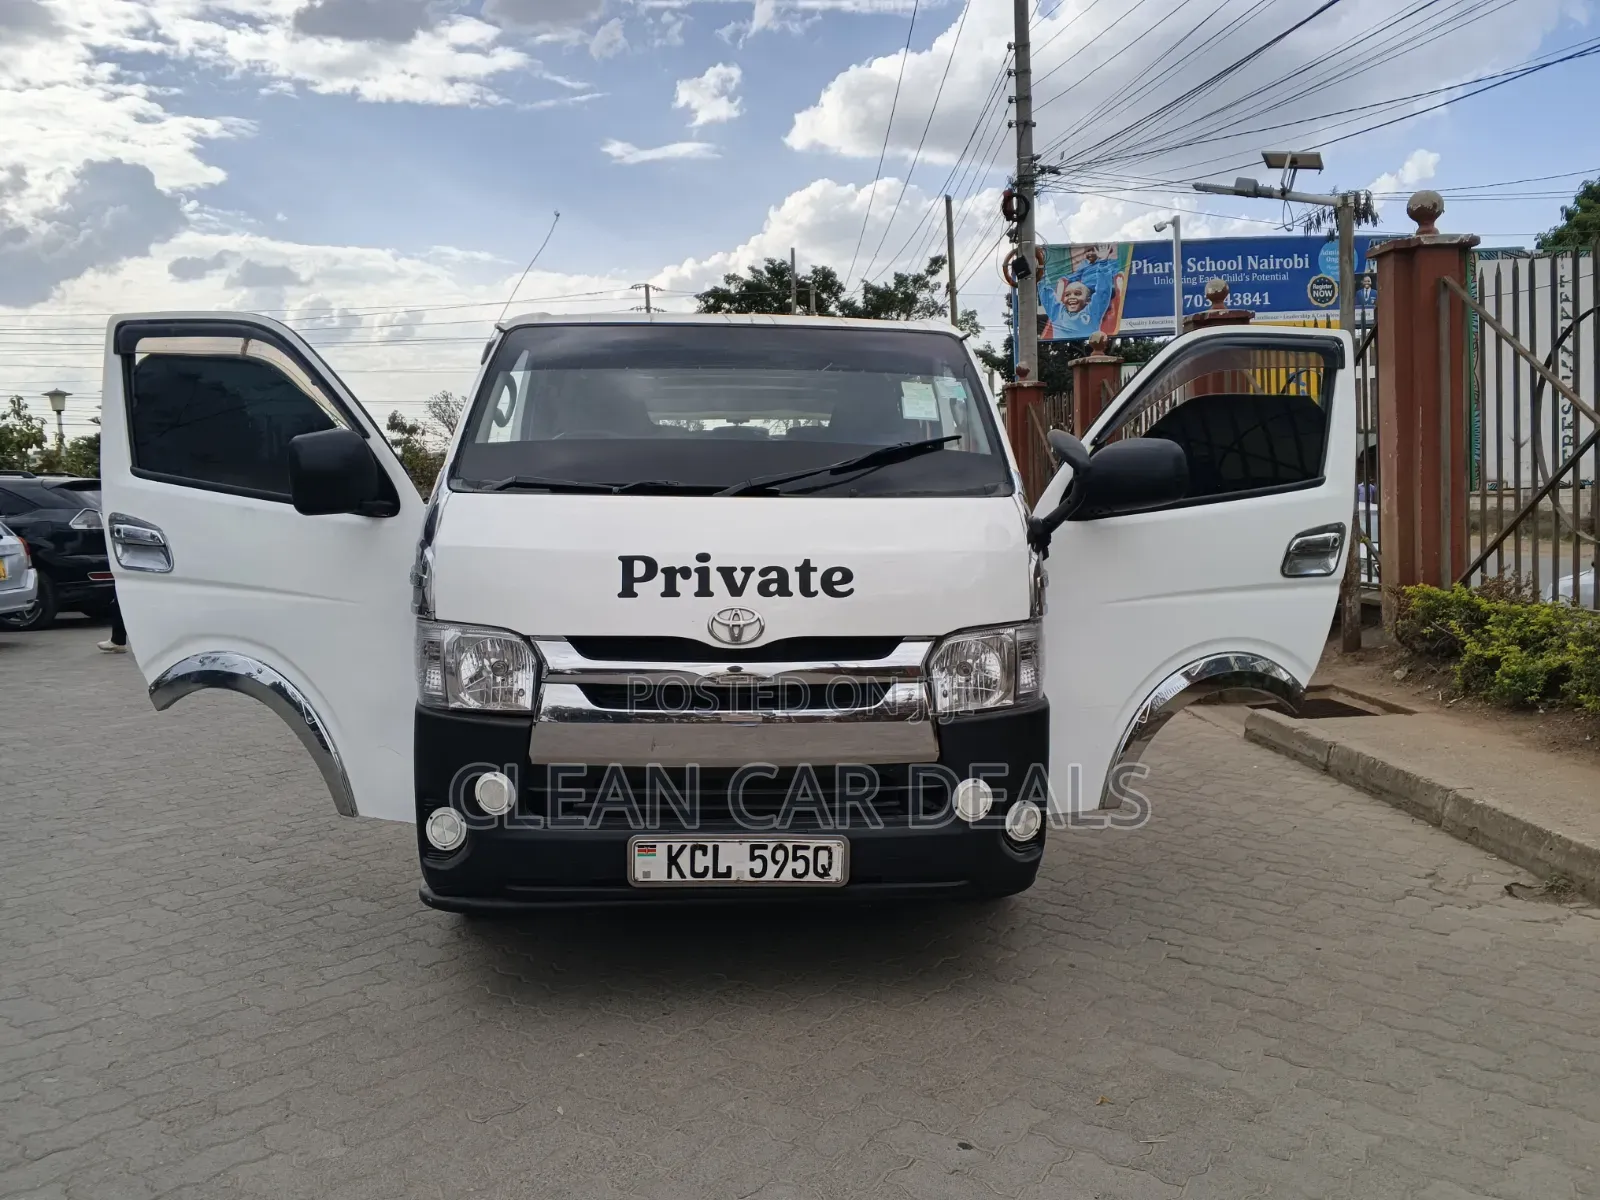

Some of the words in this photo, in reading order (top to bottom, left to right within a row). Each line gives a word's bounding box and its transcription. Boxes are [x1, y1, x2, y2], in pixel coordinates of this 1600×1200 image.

[1131, 258, 1183, 275] Phar
[1187, 255, 1243, 273] School
[1247, 253, 1310, 271] Nairobi
[1153, 274, 1198, 286] Unloing
[1252, 271, 1290, 282] Potential
[1312, 283, 1333, 291] Register
[1312, 290, 1333, 298] NOW
[617, 552, 855, 598] Private
[667, 844, 733, 880] KCL
[749, 843, 834, 880] 595Q
